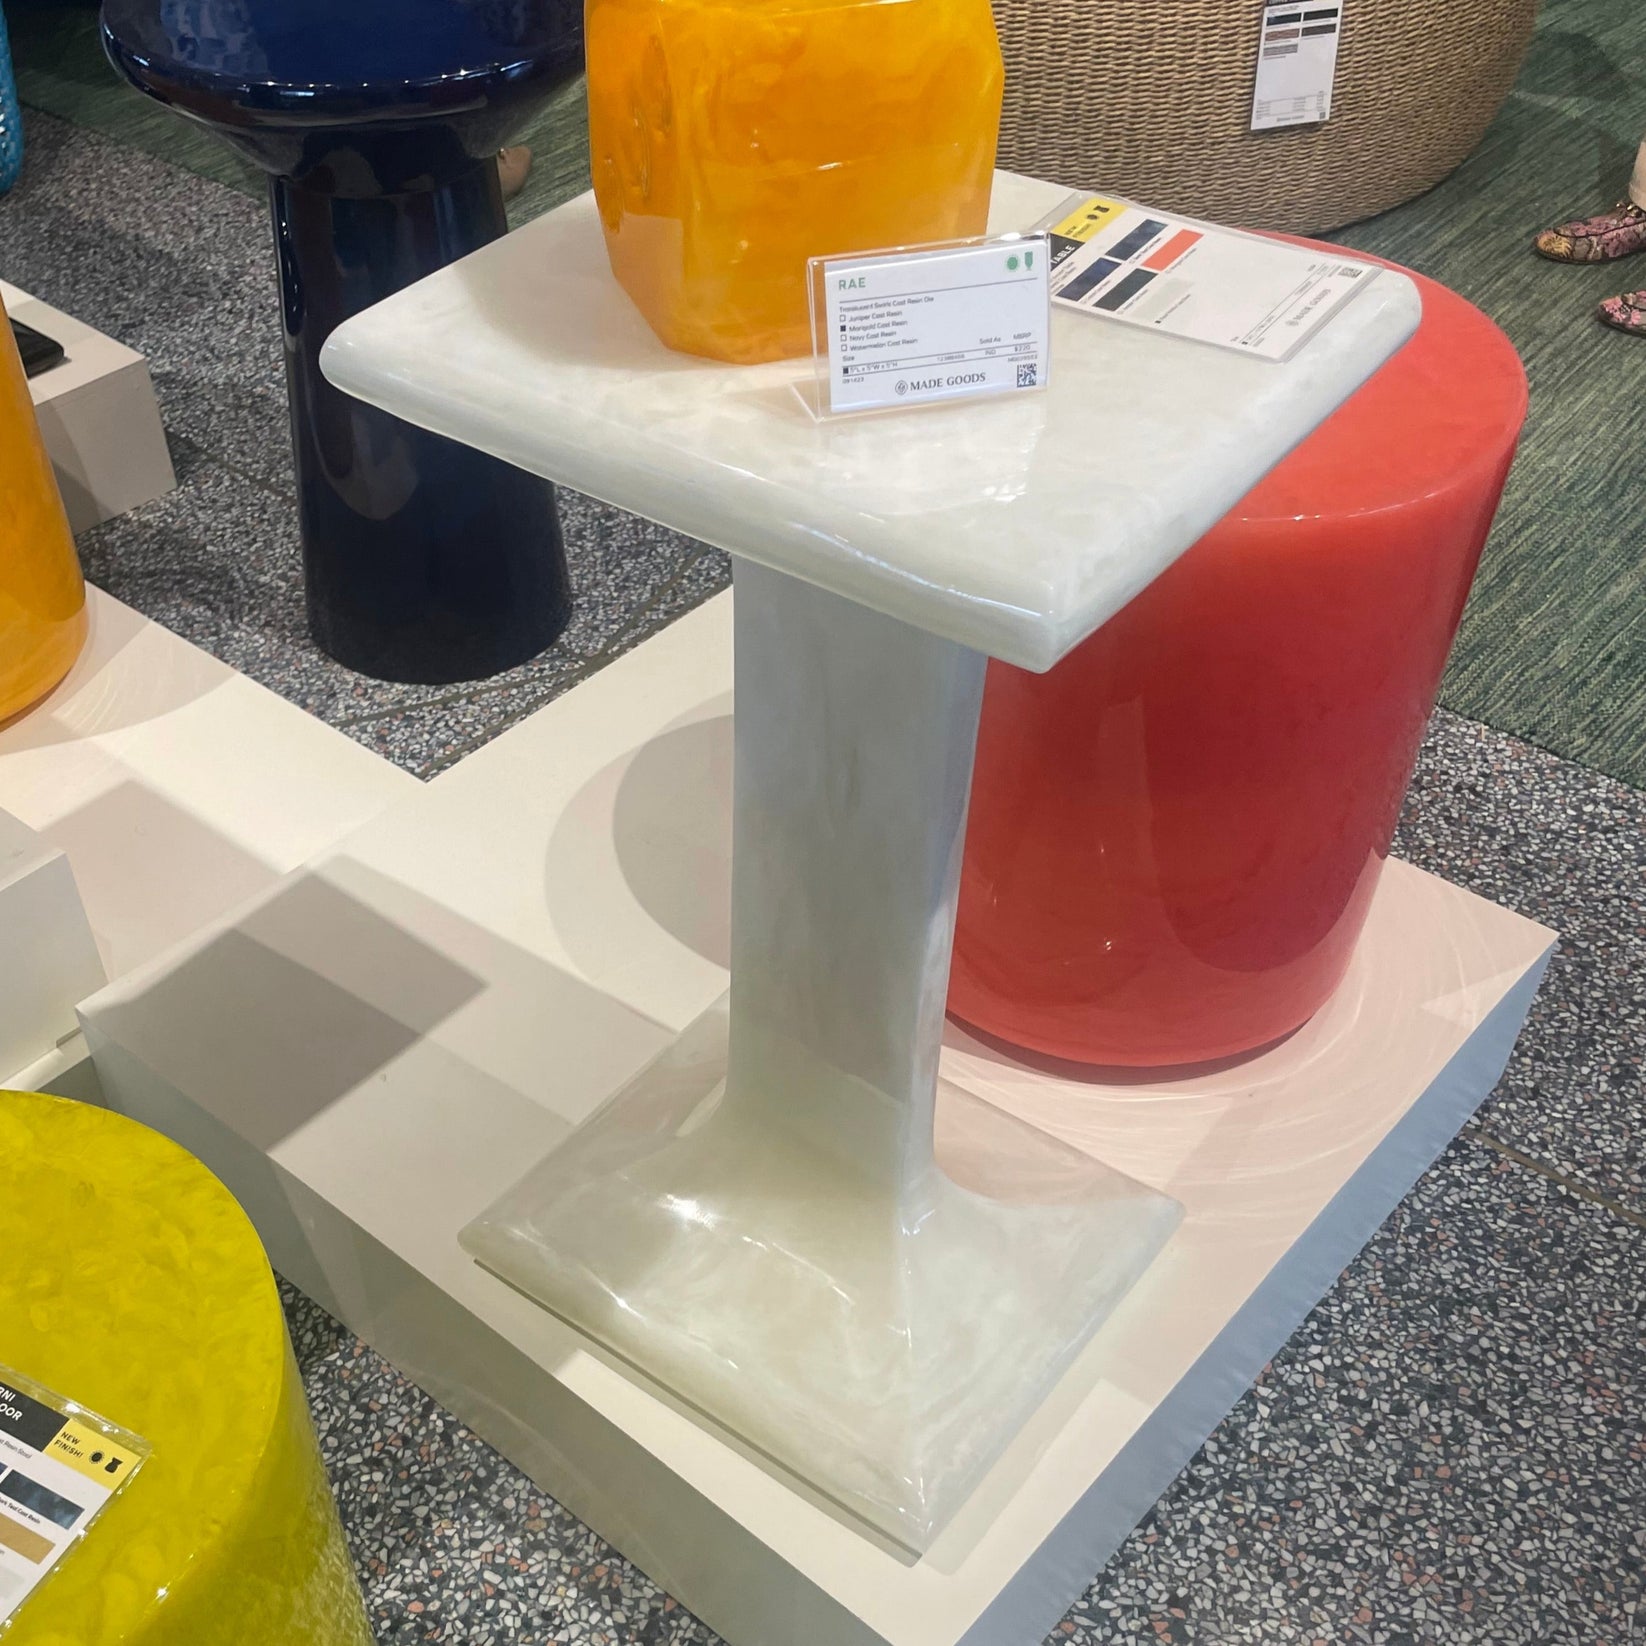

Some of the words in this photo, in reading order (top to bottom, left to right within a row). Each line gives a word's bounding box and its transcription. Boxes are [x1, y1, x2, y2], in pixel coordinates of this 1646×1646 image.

[838, 277, 866, 290] RAE
[892, 299, 906, 307] Cast
[907, 297, 922, 305] Resin
[848, 314, 871, 322] Juniper
[886, 310, 902, 318] Resin
[849, 323, 876, 332] Marigold
[877, 321, 890, 329] Cast
[849, 334, 865, 342] Navy
[866, 332, 879, 340] Cast
[849, 342, 886, 351] Watermelon
[910, 378, 943, 391] MADE
[946, 372, 986, 387] GOODS
[61, 1432, 80, 1445] NEW
[54, 1439, 83, 1458] FINISH!
